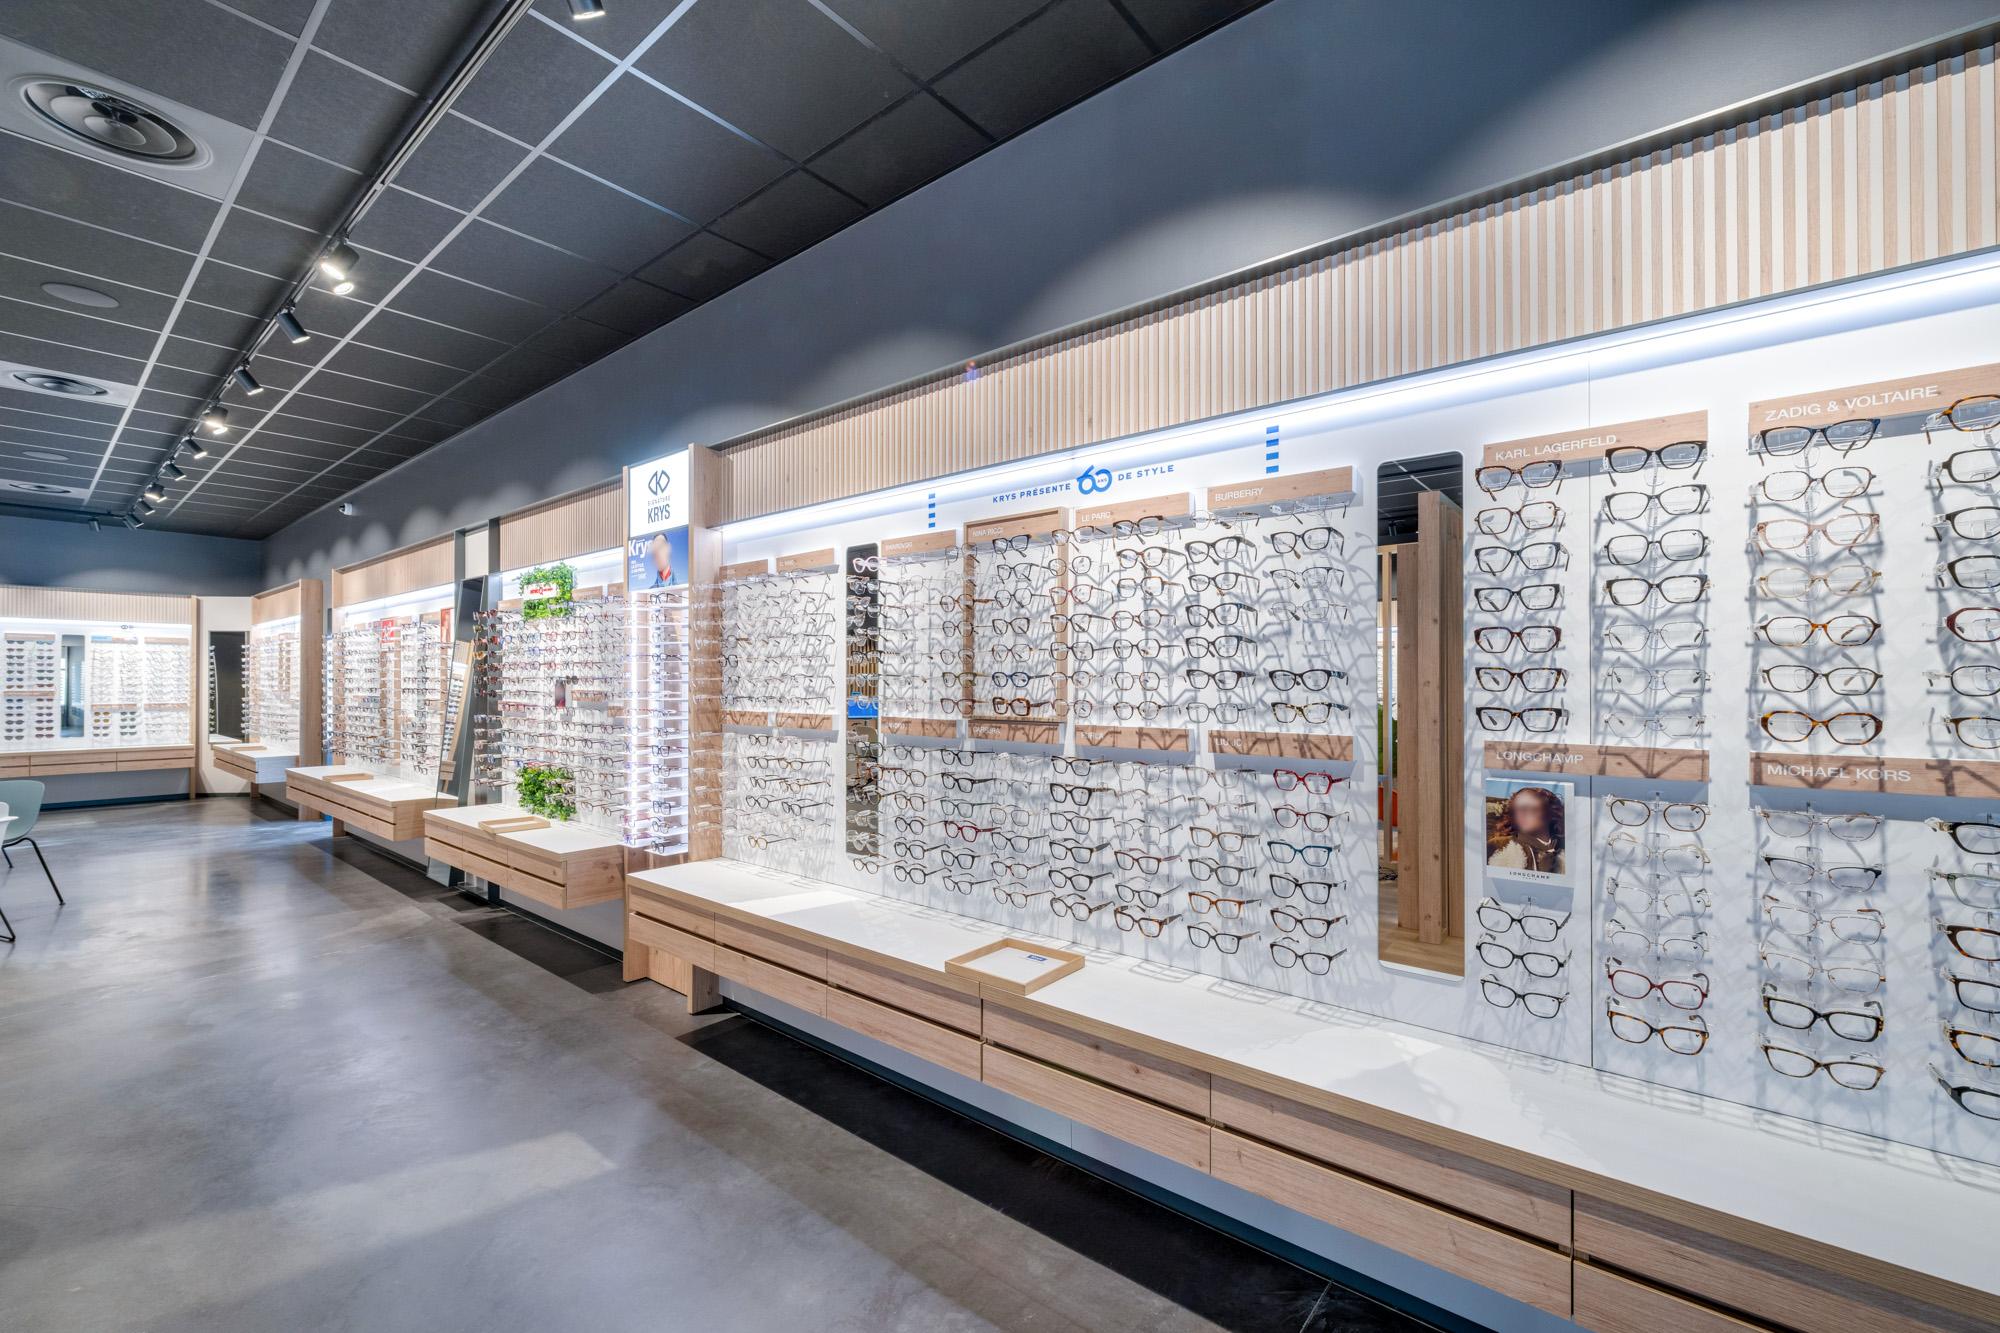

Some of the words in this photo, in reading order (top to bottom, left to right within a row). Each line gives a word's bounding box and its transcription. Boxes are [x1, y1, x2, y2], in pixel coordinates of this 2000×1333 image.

[1765, 403, 1821, 422] ZADIG
[1827, 400, 1840, 412] &
[1844, 385, 1939, 409] VOLTAIRE
[1496, 448, 1530, 461] KARL
[1534, 434, 1617, 455] LAGERFELD
[993, 492, 1017, 503] KRYS
[1020, 483, 1071, 499] PRÉSENTE
[1076, 465, 1113, 495] 60
[1118, 471, 1132, 481] DE
[1137, 464, 1175, 478] STYLE
[1215, 487, 1264, 502] BURBERRY
[647, 503, 671, 524] KRYS
[1496, 751, 1584, 764] LONGCHAMP
[1767, 764, 1850, 779] MICHAEL
[1856, 768, 1911, 782] KORS
[1509, 871, 1550, 880] LONGCHAMP
